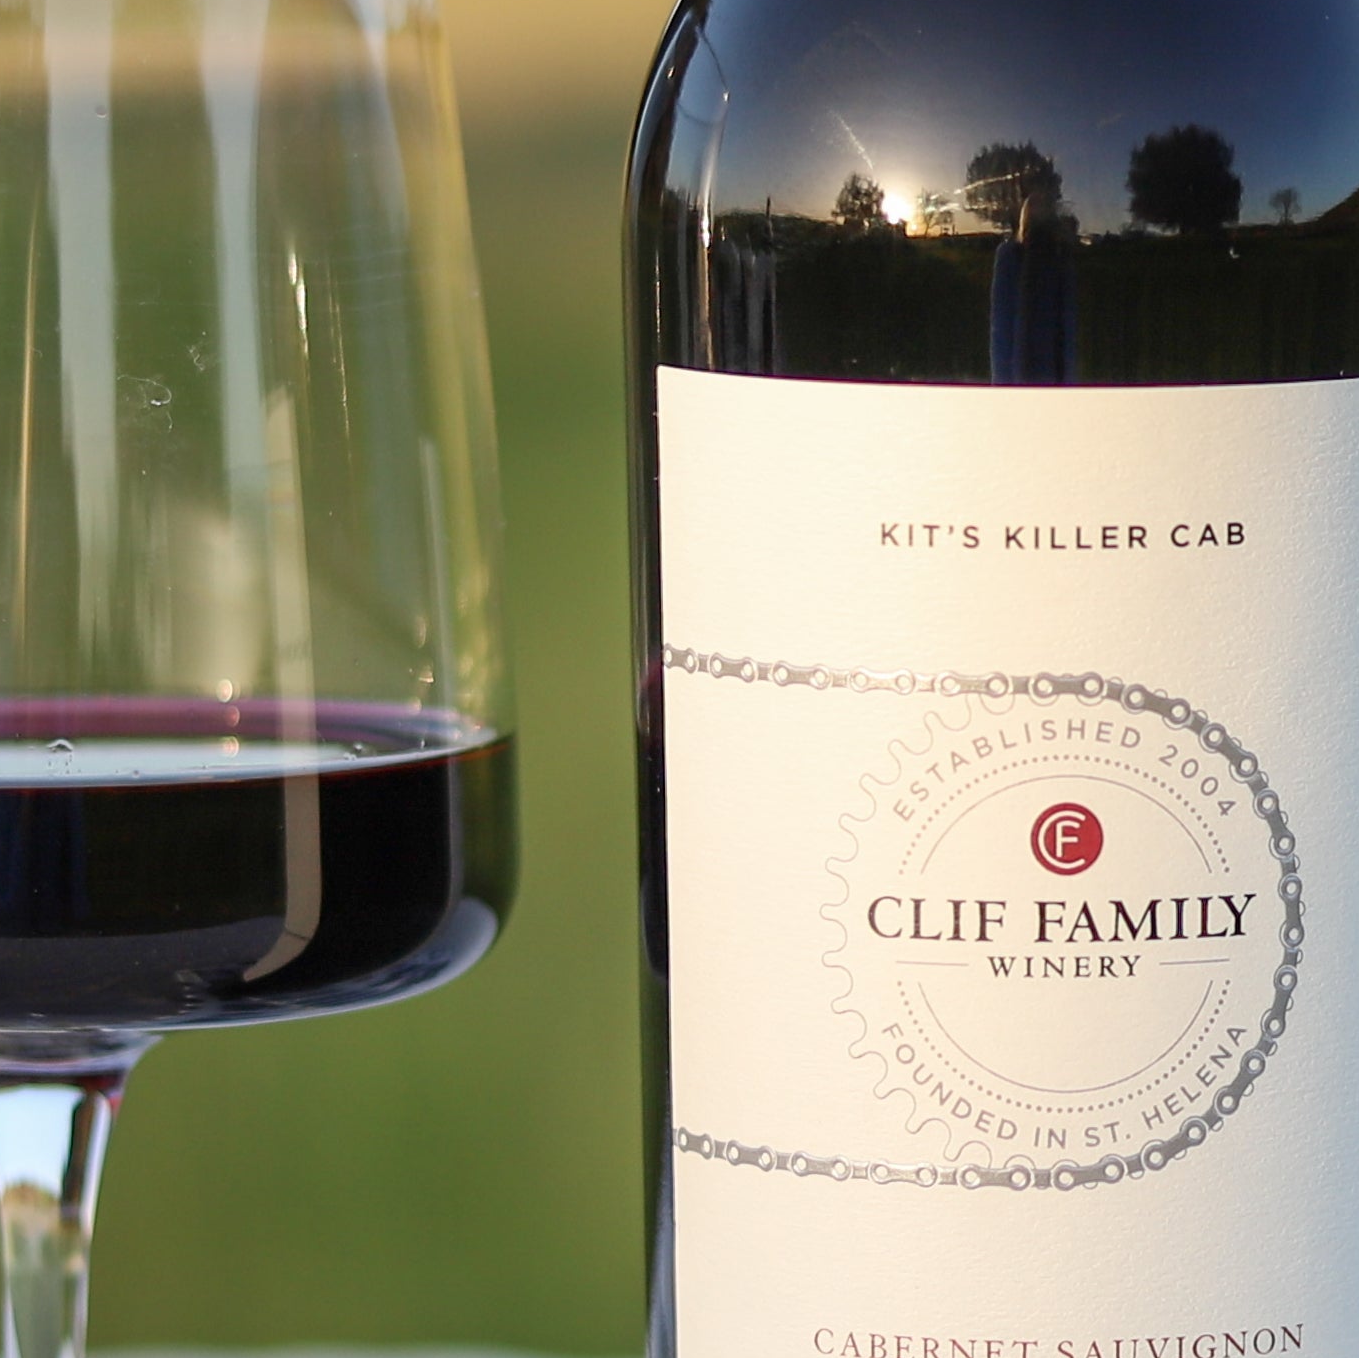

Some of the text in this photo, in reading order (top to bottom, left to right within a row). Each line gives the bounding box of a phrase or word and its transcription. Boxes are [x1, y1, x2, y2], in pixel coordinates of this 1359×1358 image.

[880, 522, 1246, 551] KIT'S KILLER CAB
[892, 718, 1237, 822] ESTABLISHED 2004
[867, 894, 1257, 943] CLIF FAMILY
[987, 955, 1142, 979] WINERY
[881, 1022, 1247, 1149] FOUNDED IN ST. HELENA
